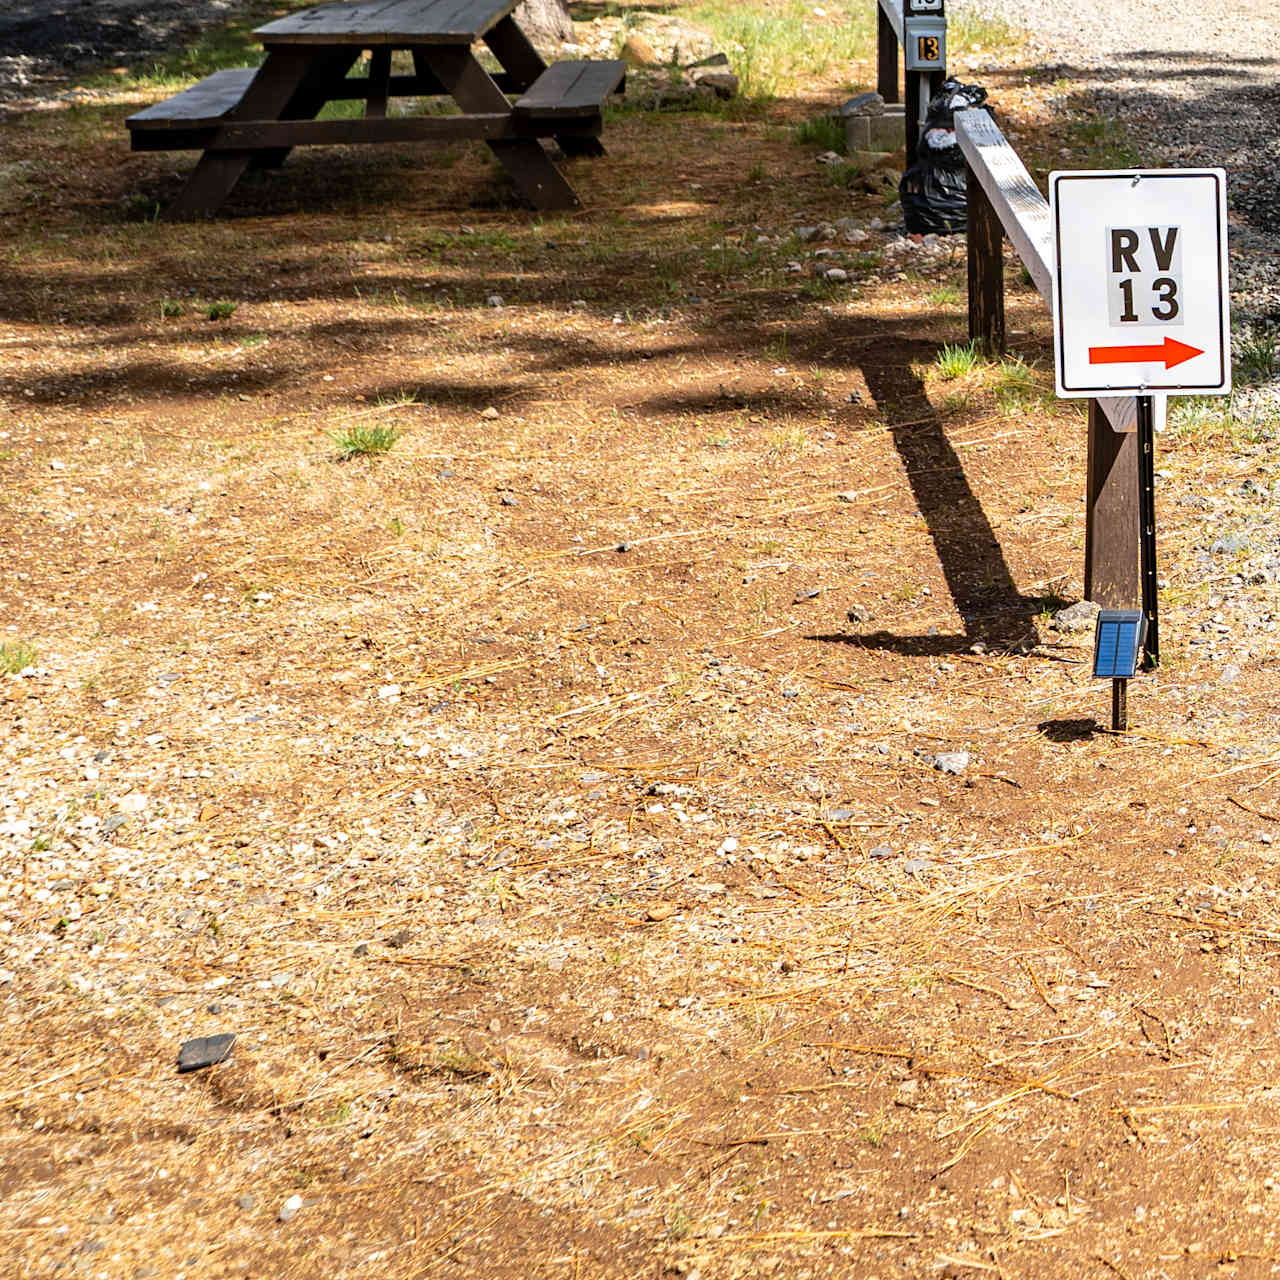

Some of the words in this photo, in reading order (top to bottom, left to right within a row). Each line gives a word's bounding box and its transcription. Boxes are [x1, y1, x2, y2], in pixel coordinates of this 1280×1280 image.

[919, 37, 939, 60] 13
[1111, 227, 1179, 273] RV
[1118, 277, 1180, 323] 13
